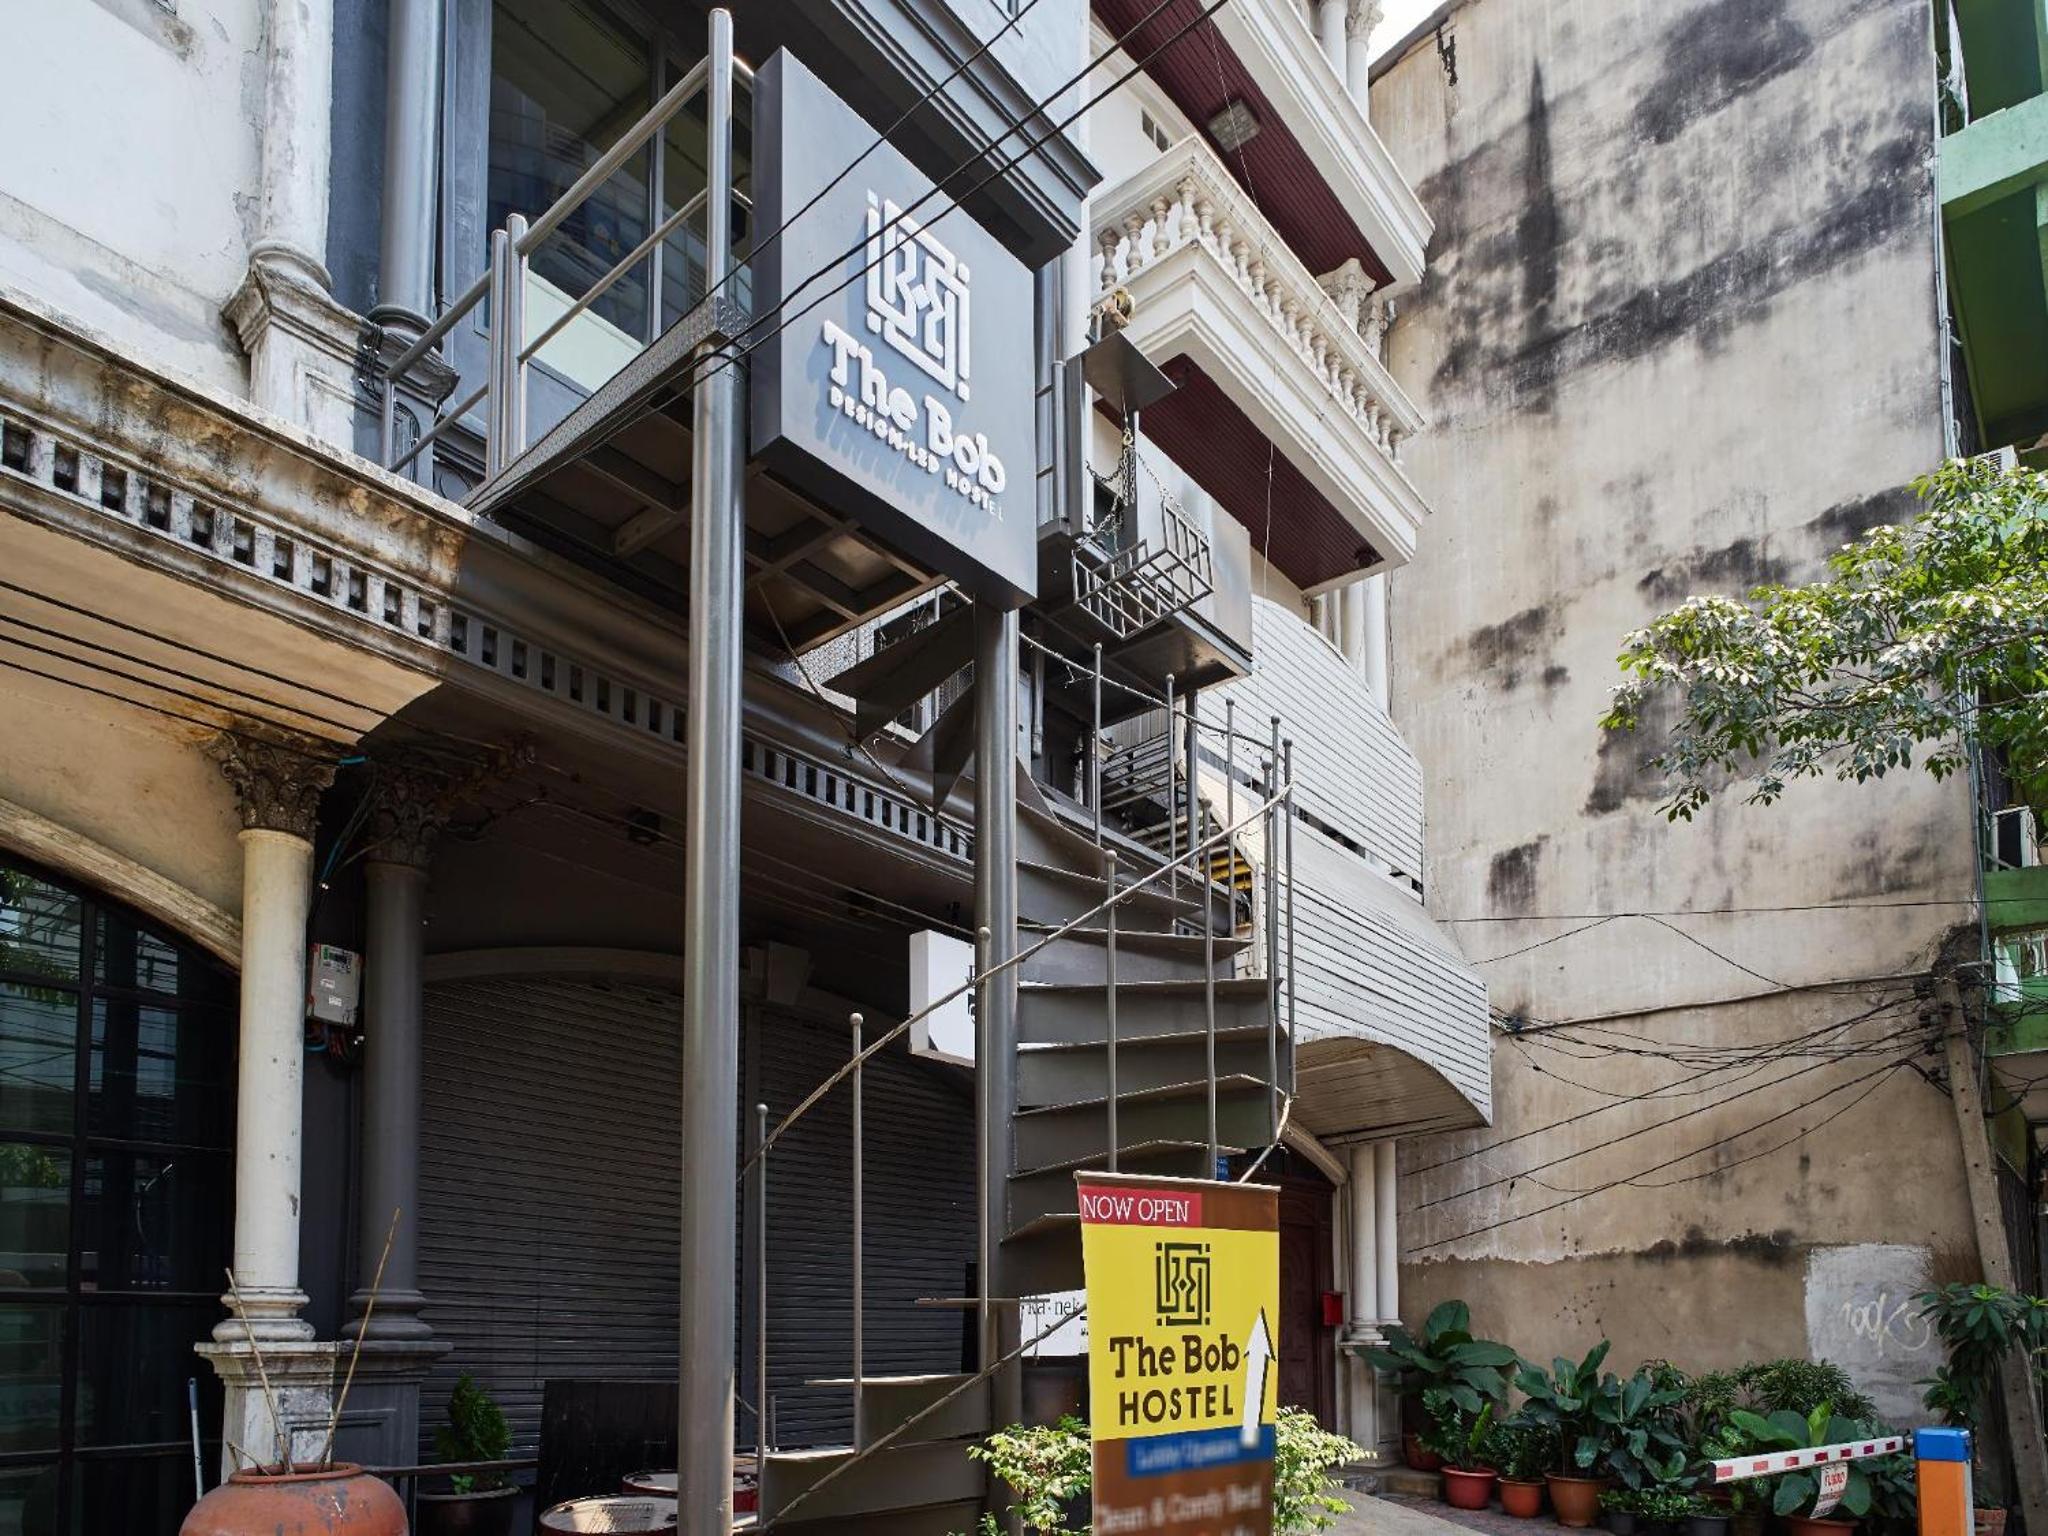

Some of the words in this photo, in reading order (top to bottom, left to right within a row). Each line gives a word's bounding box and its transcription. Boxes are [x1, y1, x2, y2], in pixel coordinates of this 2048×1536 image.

[823, 319, 918, 431] The
[924, 394, 1006, 494] Bob
[944, 468, 1004, 521] HOSTEL
[1082, 1194, 1133, 1221] NOW
[1137, 1197, 1189, 1222] OPEN
[1108, 1336, 1177, 1378] The
[1181, 1333, 1240, 1375] Bob
[1119, 1384, 1234, 1426] HOSTEL
